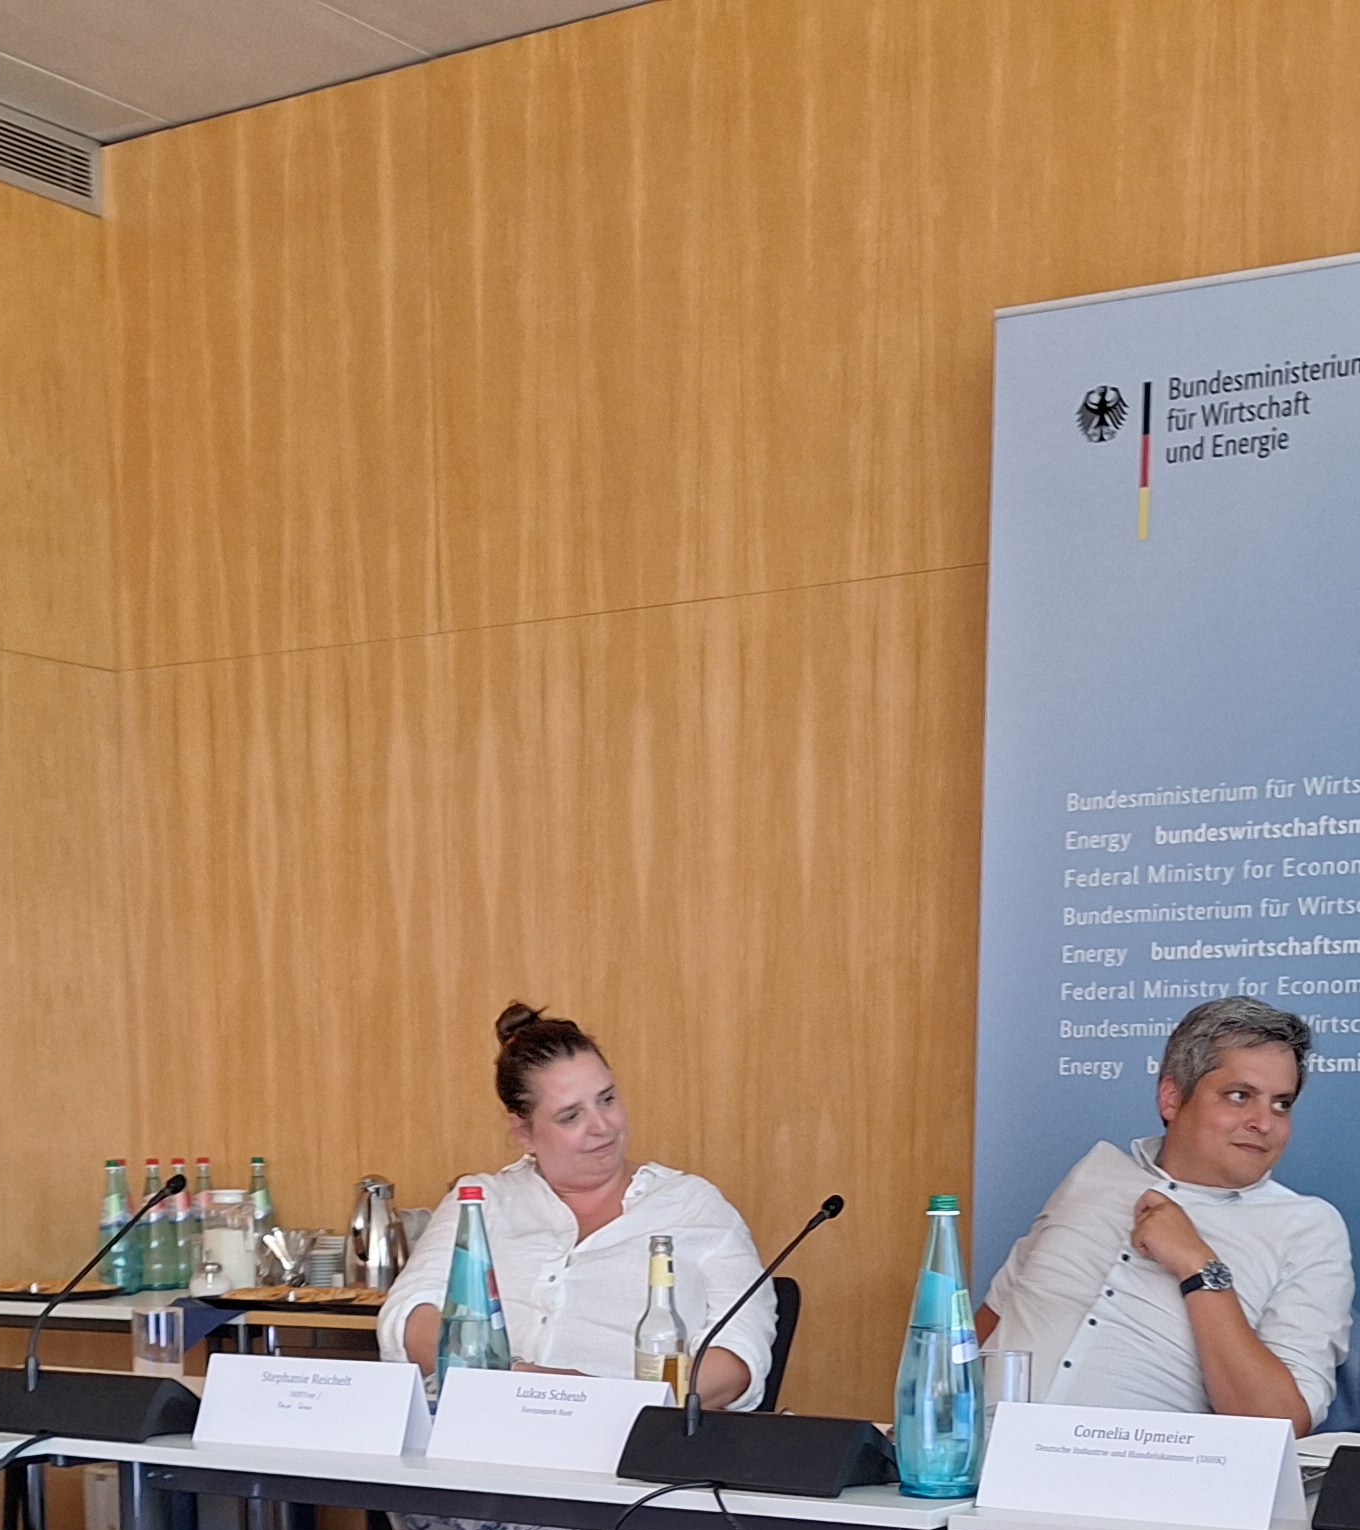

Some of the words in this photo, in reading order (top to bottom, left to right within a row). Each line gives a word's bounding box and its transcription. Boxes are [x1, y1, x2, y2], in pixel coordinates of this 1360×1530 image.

[1167, 409, 1196, 433] für
[1203, 392, 1311, 428] Wirtschaft
[1166, 437, 1205, 464] und
[1212, 427, 1289, 460] Energie
[1067, 782, 1257, 813] Bundesministerium
[1265, 779, 1295, 798] für
[1066, 830, 1132, 853] Energy
[1064, 866, 1139, 888] Federal
[1147, 861, 1235, 886] Ministry
[1243, 858, 1275, 880] for
[1063, 901, 1252, 926] Bundesministerium
[1260, 898, 1290, 918] für
[1062, 945, 1128, 966] Energy
[1060, 980, 1135, 1001] Federal
[1143, 978, 1231, 1000] Ministry
[1238, 976, 1268, 997] for
[1059, 1018, 1179, 1038] Bundesmini
[1059, 1057, 1124, 1079] Energy
[516, 1387, 547, 1399] Lukas
[1074, 1425, 1130, 1440] Cornelia
[1135, 1429, 1194, 1445] Upmeier
